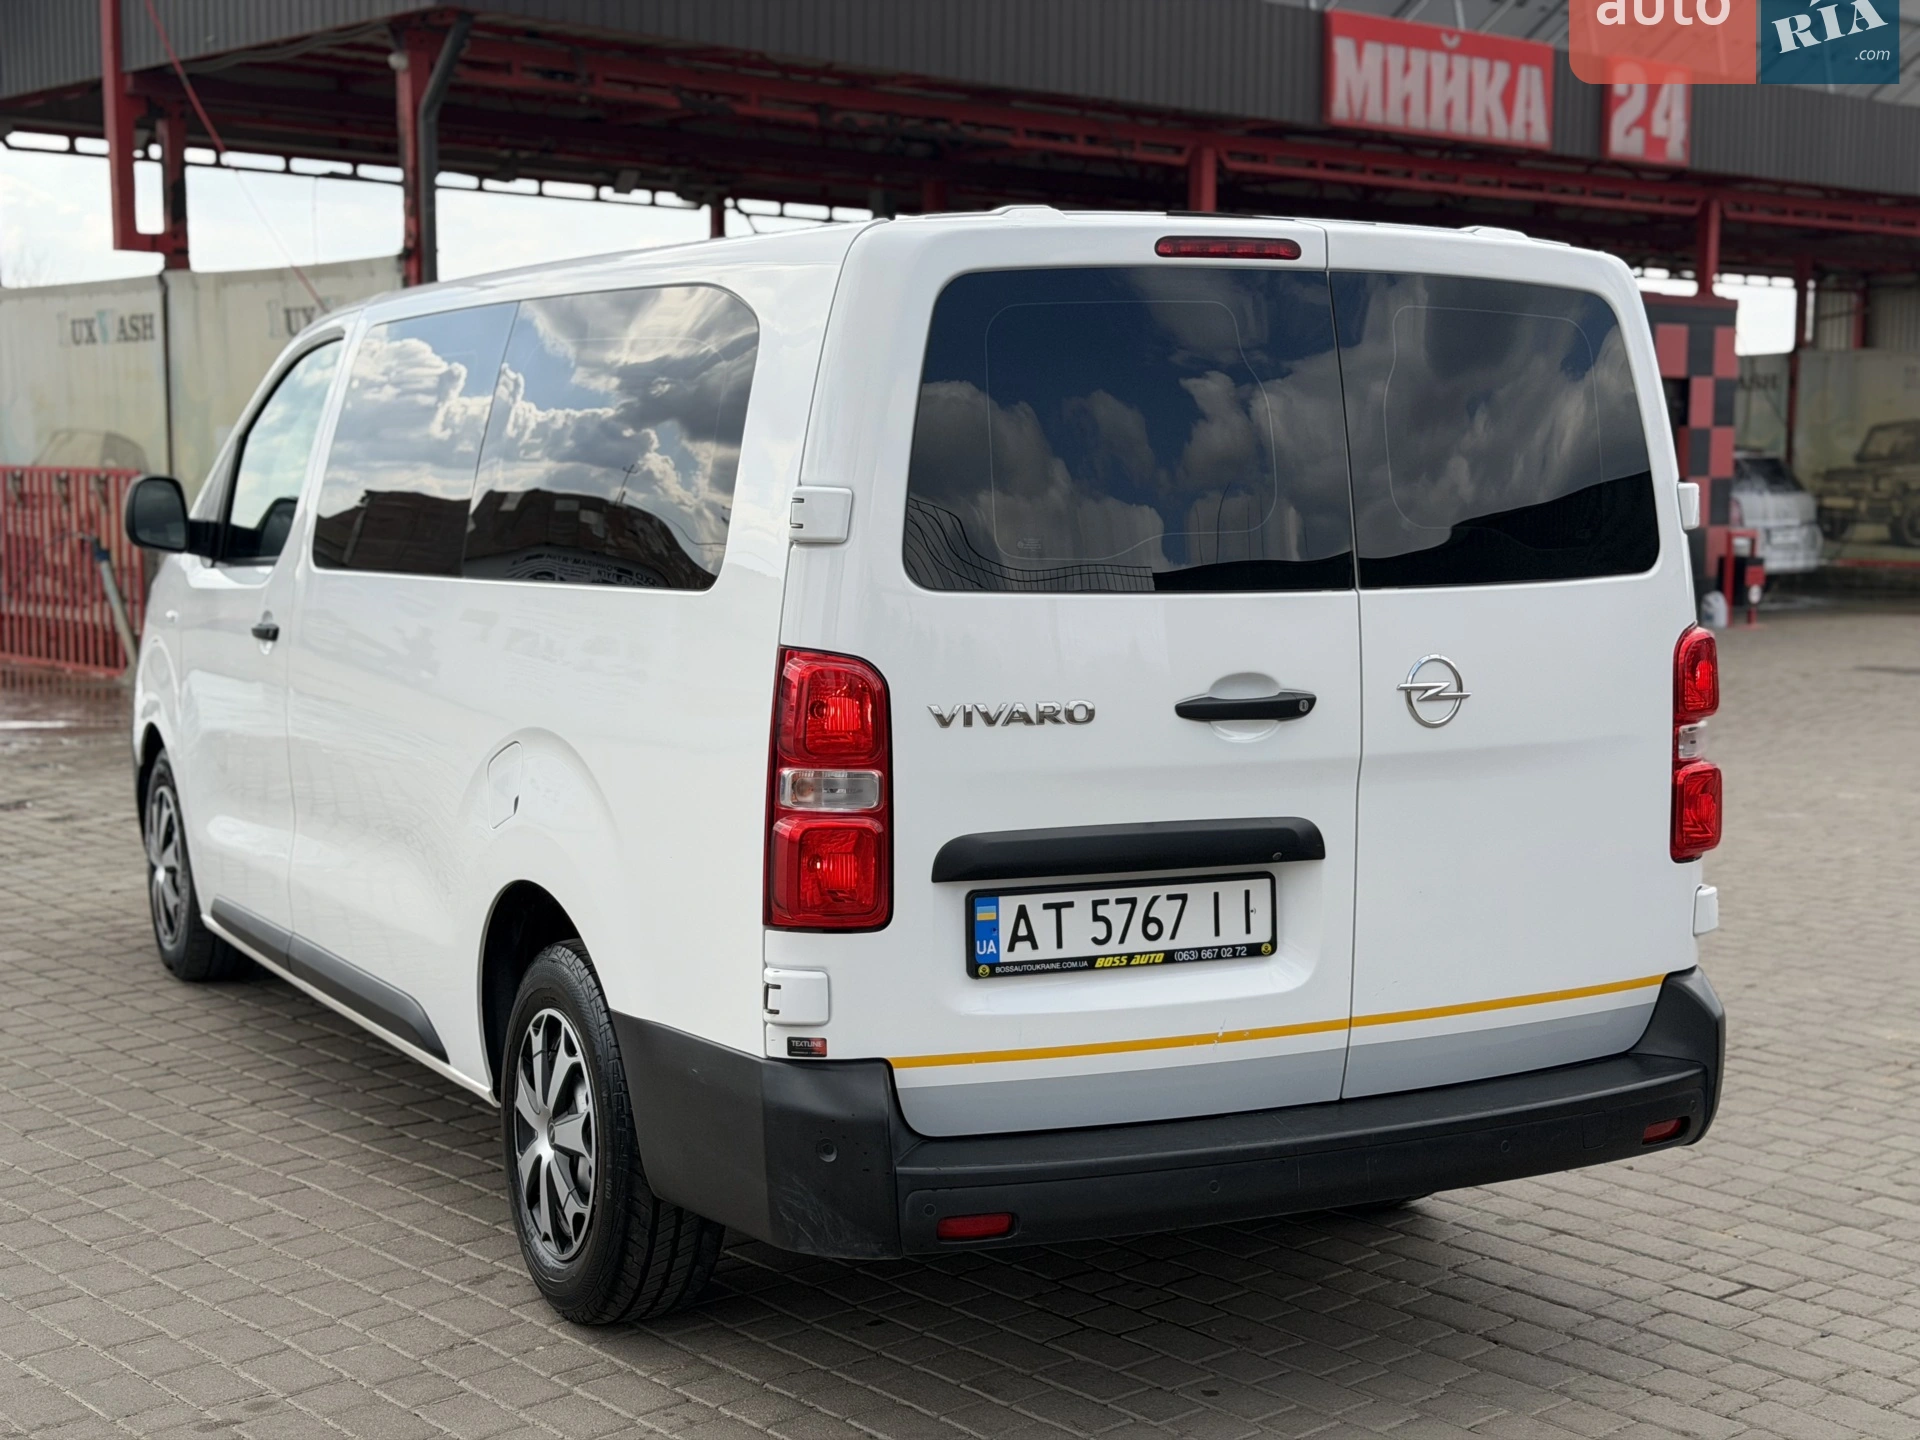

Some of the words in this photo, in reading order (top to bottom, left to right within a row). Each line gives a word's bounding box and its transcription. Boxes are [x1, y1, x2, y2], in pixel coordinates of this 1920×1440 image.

[1333, 33, 1550, 144] МИЙКА
[1609, 62, 1687, 160] 24
[927, 700, 1096, 728] VIVARO
[1007, 901, 1075, 952] AT
[1091, 892, 1188, 947] 5767
[976, 939, 997, 955] UA
[995, 960, 1089, 974] BOSSAUTOUKRAINE.COM.UA
[1094, 956, 1128, 968] BOSS
[1130, 952, 1165, 965] AUTO
[1174, 949, 1199, 962] (063)
[1201, 948, 1219, 960] 667
[1221, 946, 1233, 958] 02
[1235, 945, 1247, 957] 72
